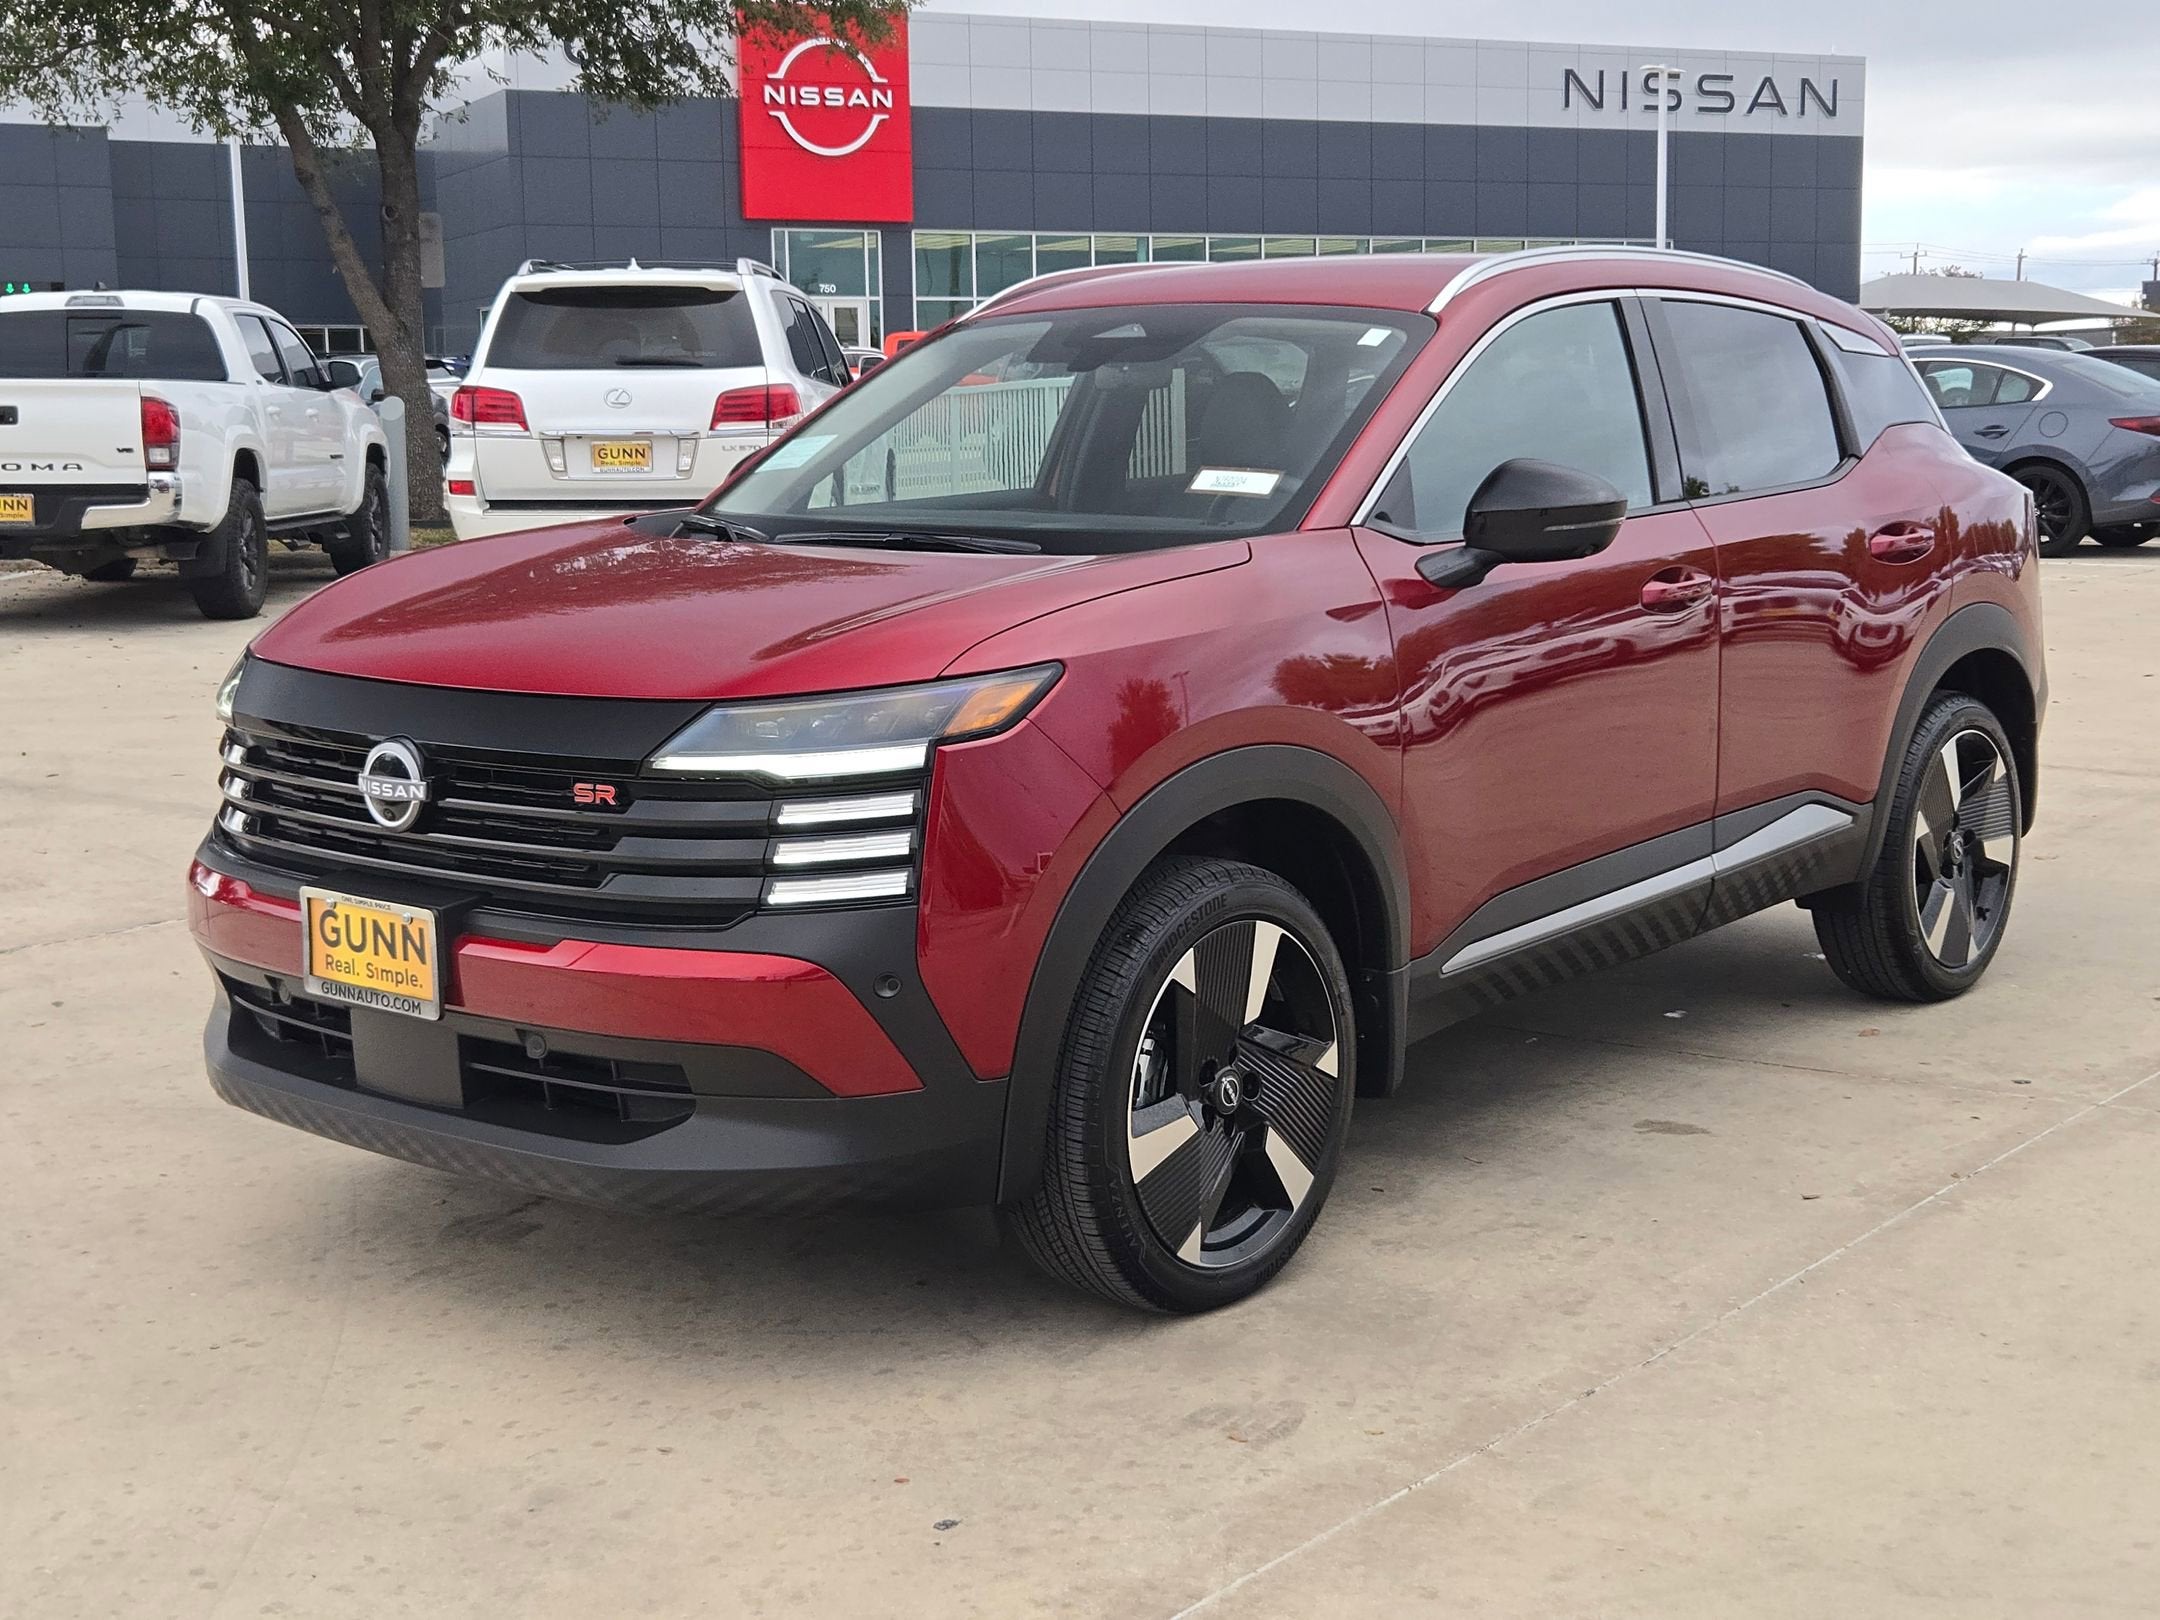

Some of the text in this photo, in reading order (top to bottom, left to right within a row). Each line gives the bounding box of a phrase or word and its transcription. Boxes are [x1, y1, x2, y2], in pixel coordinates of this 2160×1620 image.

[763, 85, 893, 108] NISSAN
[1563, 68, 1838, 118] NISSAN
[819, 283, 837, 294] 750
[597, 447, 646, 460] GUNN
[359, 777, 427, 799] NISSAN
[573, 782, 617, 806] SR
[319, 909, 427, 965] GUNN
[325, 953, 360, 977] Real.
[321, 981, 422, 1015] GUNNAUTO.COM
